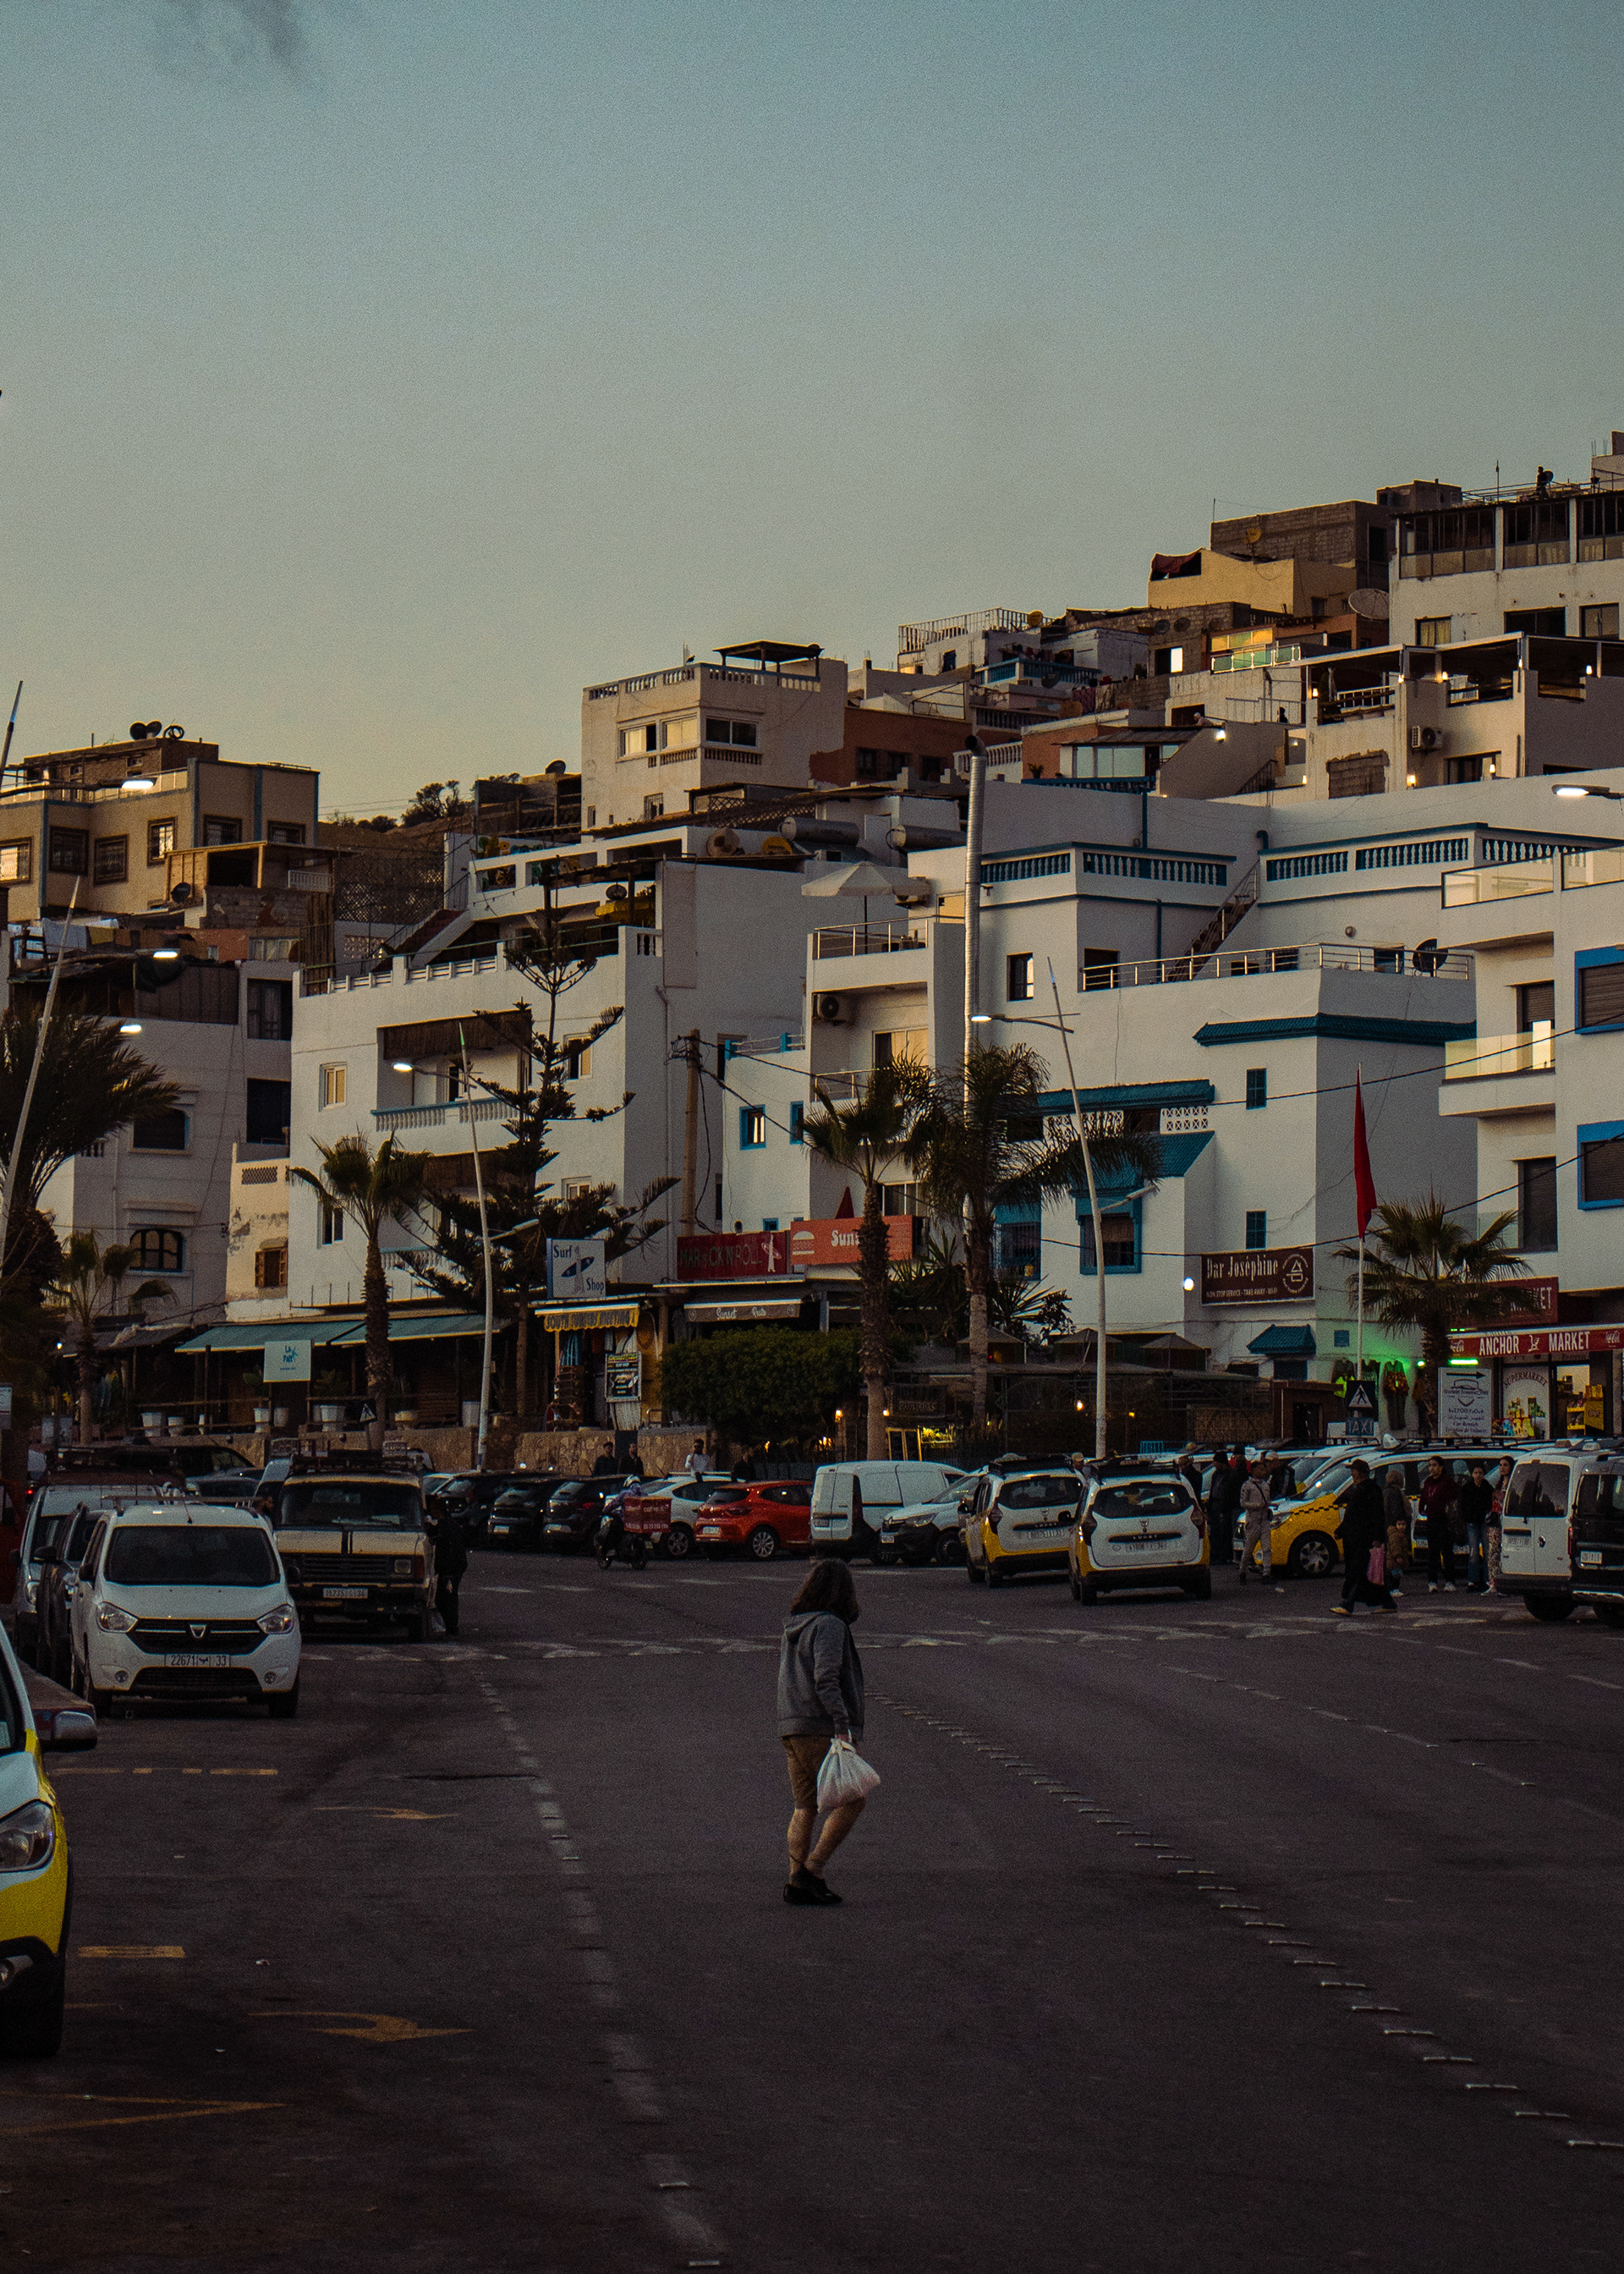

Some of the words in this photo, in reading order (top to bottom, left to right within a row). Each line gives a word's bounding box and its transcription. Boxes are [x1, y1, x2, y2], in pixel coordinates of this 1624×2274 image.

[553, 1244, 573, 1258] Surf
[1206, 1258, 1225, 1279] Dar
[1227, 1253, 1279, 1283] Joséphine
[586, 1277, 605, 1294] Shop
[1479, 1334, 1521, 1357] ANCHOR
[1548, 1331, 1590, 1352] MARKET
[1504, 1370, 1549, 1389] SUPERMARKET
[1347, 1419, 1373, 1435] TAXI
[171, 1655, 195, 1667] 22671
[216, 1655, 227, 1667] 33
